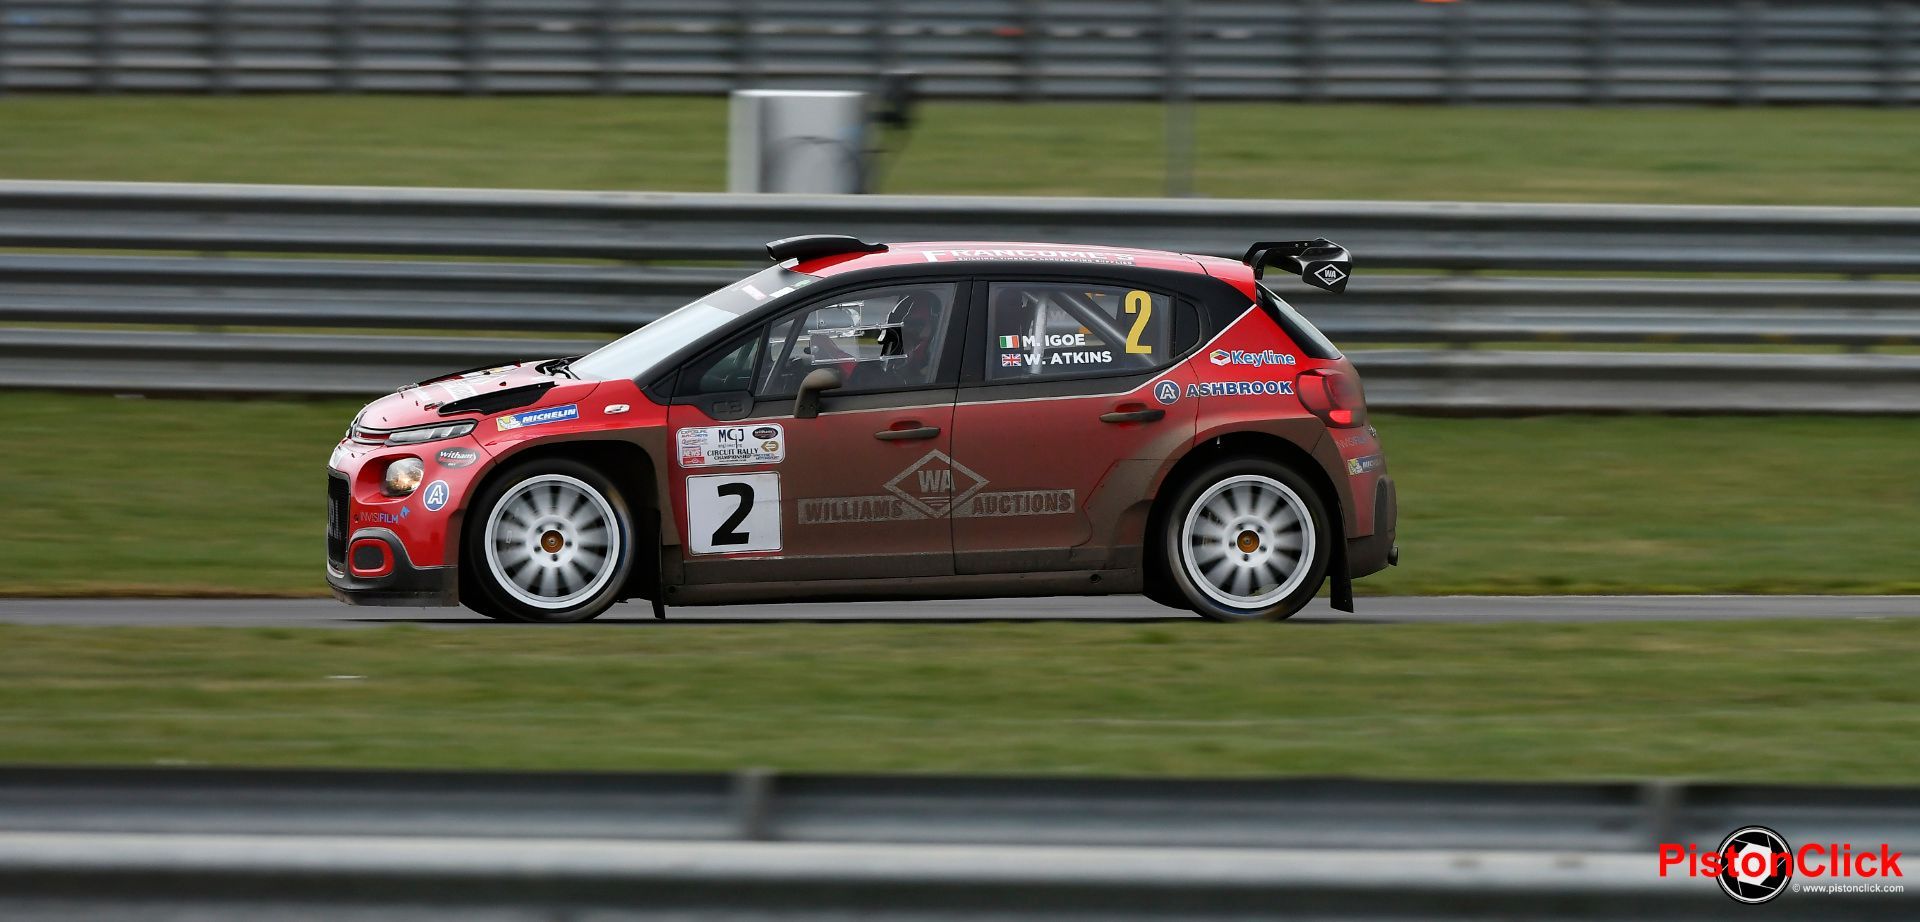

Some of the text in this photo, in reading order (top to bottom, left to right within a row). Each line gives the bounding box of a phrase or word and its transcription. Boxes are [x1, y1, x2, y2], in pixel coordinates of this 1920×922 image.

[1325, 270, 1336, 278] WA
[1124, 290, 1152, 354] 2
[1022, 334, 1086, 347] M. IGOE
[1024, 351, 1112, 366] W. ATKINS
[1231, 350, 1296, 367] Keyline
[1160, 384, 1176, 399] A
[1185, 381, 1294, 397] ASHBROOK
[522, 408, 577, 423] MICHELIN
[917, 470, 956, 493] WA
[427, 485, 443, 504] A
[805, 500, 905, 521] WILLIAMS
[971, 493, 1071, 515] AUCTIONS
[711, 482, 754, 546] 2
